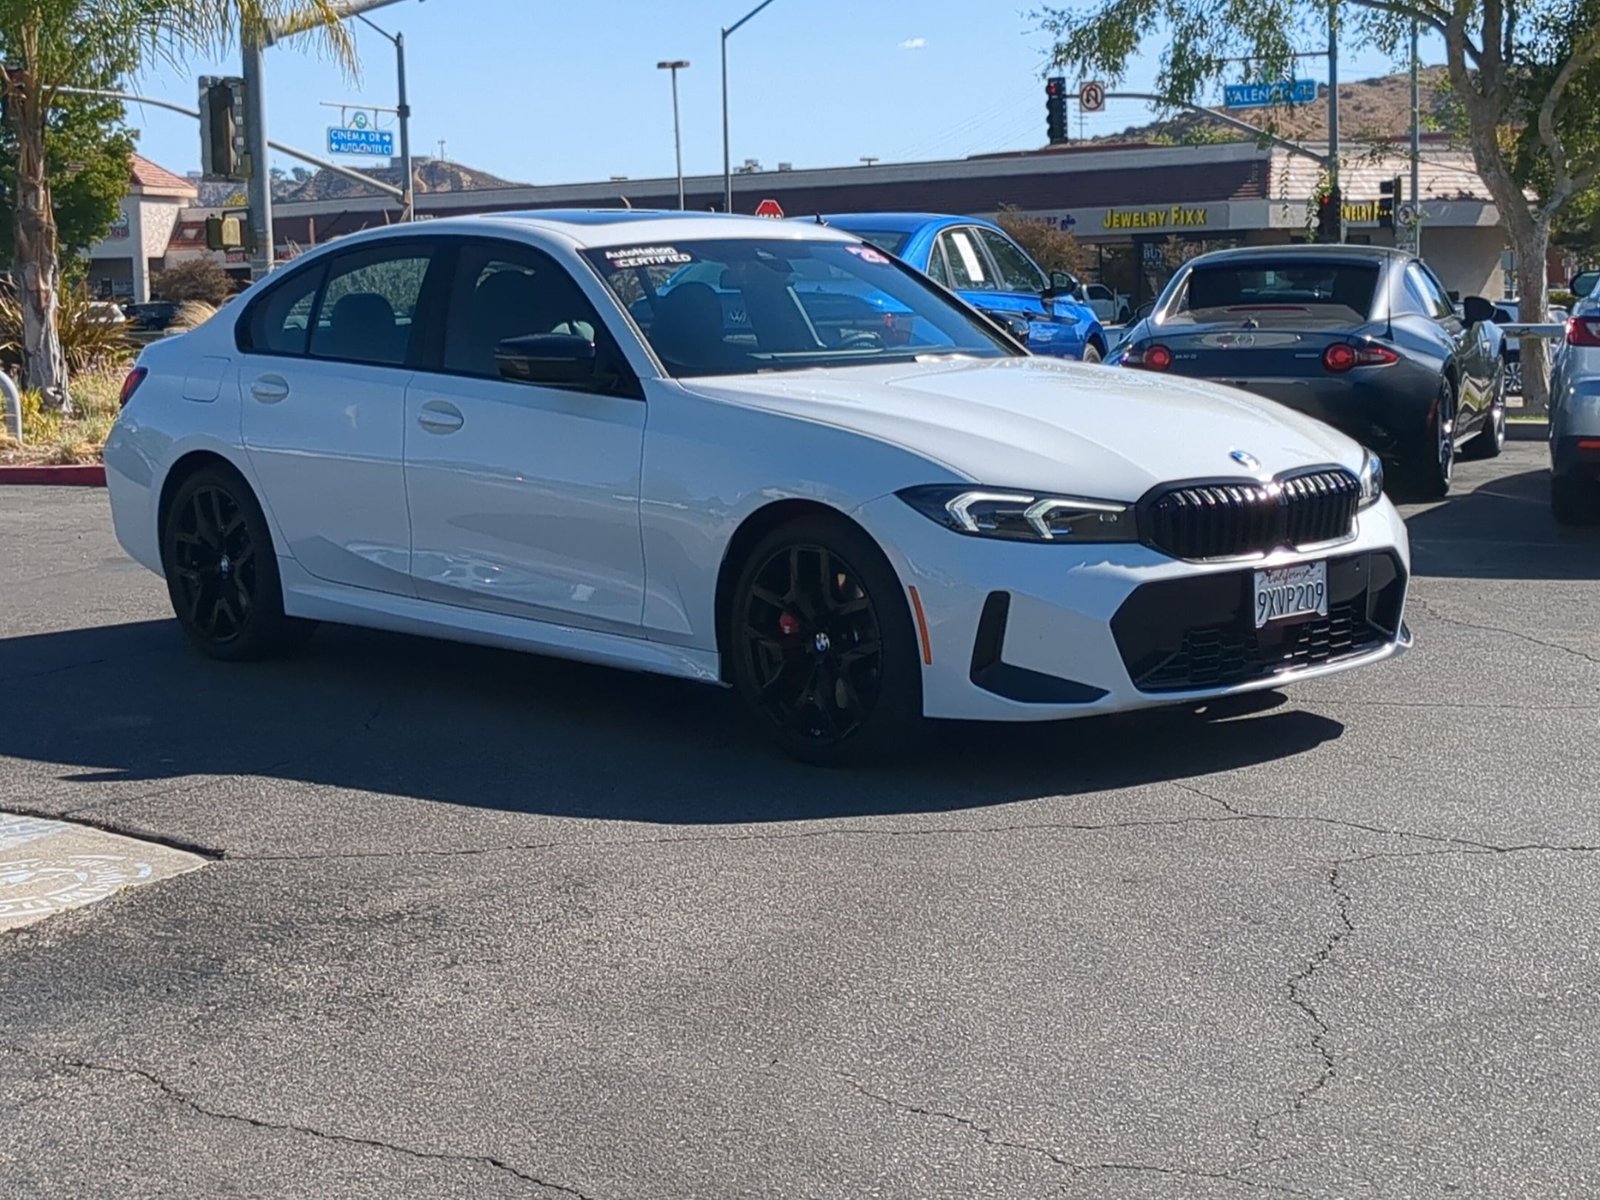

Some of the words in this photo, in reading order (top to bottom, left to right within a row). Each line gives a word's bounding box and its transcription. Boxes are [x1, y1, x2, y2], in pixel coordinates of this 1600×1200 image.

[331, 130, 366, 142] CINEMA
[368, 132, 381, 142] DR
[1103, 209, 1167, 229] JEWELRY
[620, 254, 691, 268] CERTIFIED
[1258, 581, 1324, 621] 9XVP209
